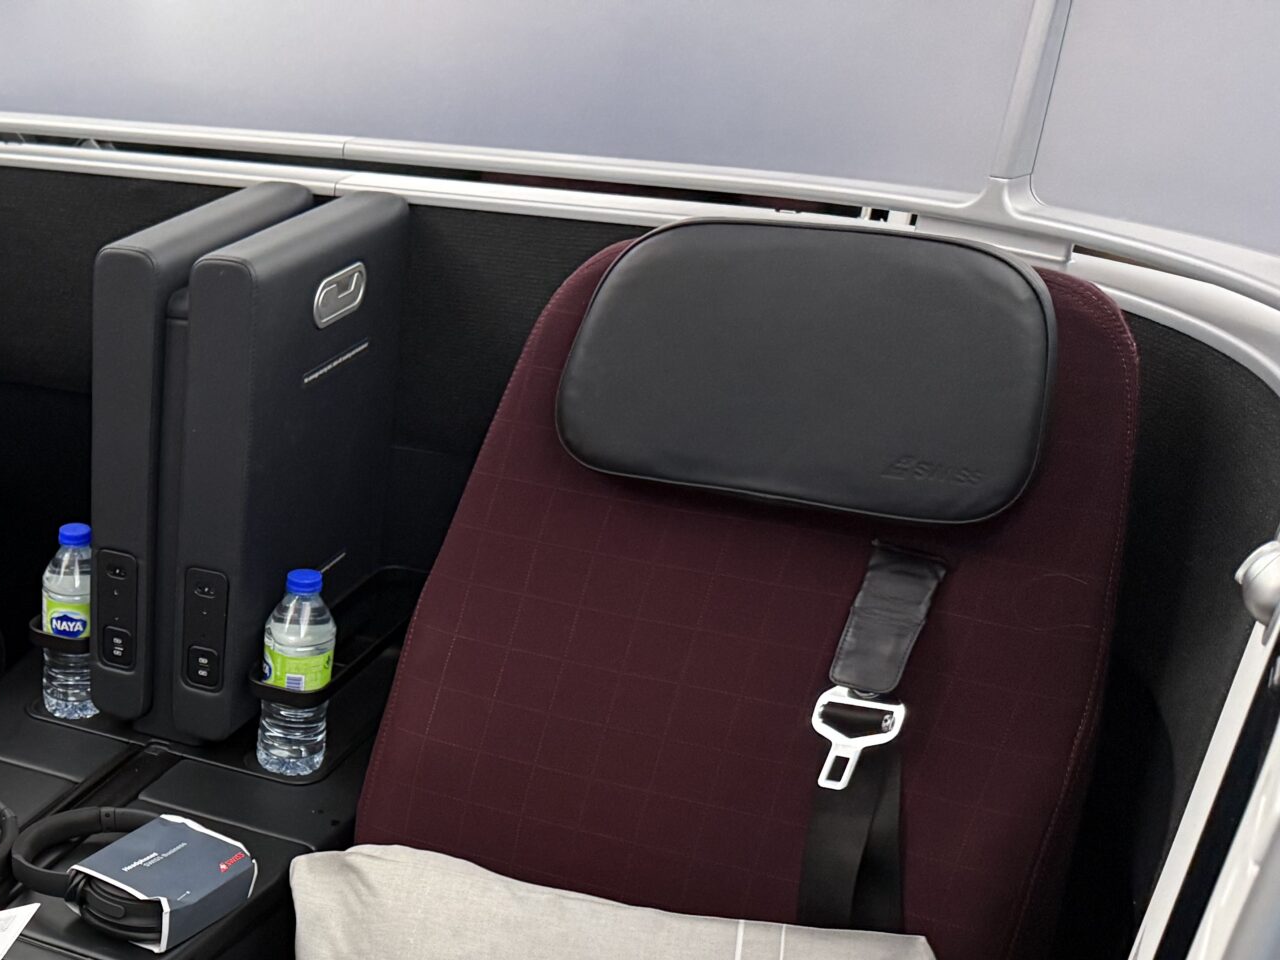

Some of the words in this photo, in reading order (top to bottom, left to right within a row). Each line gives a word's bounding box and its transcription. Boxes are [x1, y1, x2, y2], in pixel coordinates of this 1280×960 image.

[52, 618, 83, 632] NAYA
[121, 852, 158, 871] Headphones
[143, 856, 163, 866] SWISS
[161, 842, 187, 856] Business
